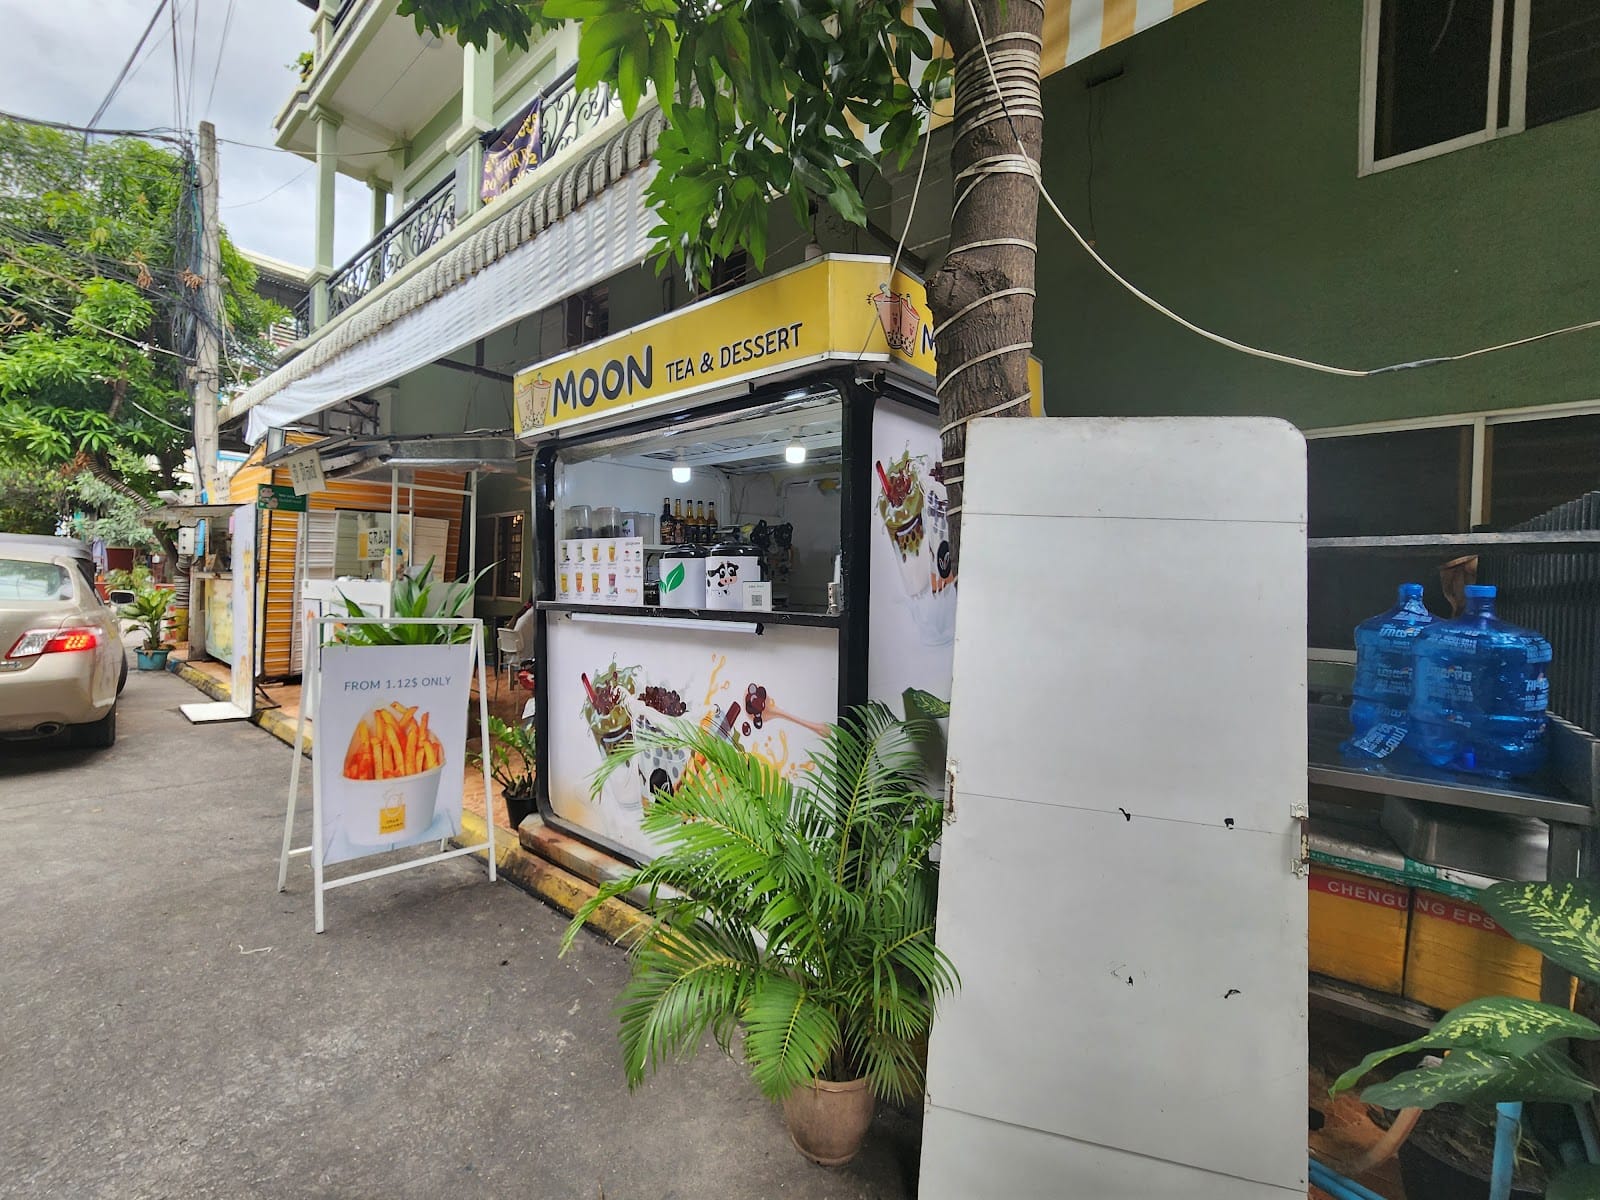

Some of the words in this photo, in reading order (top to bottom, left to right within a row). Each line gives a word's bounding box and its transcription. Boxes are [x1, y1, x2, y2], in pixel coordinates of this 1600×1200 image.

[553, 345, 652, 417] MOON
[666, 359, 695, 383] TEA
[700, 352, 714, 374] &
[720, 323, 803, 369] DESSERT
[344, 680, 381, 691] FROM
[386, 677, 418, 689] 1.12$
[422, 676, 451, 687] ONLY
[1452, 907, 1497, 931] EPS
